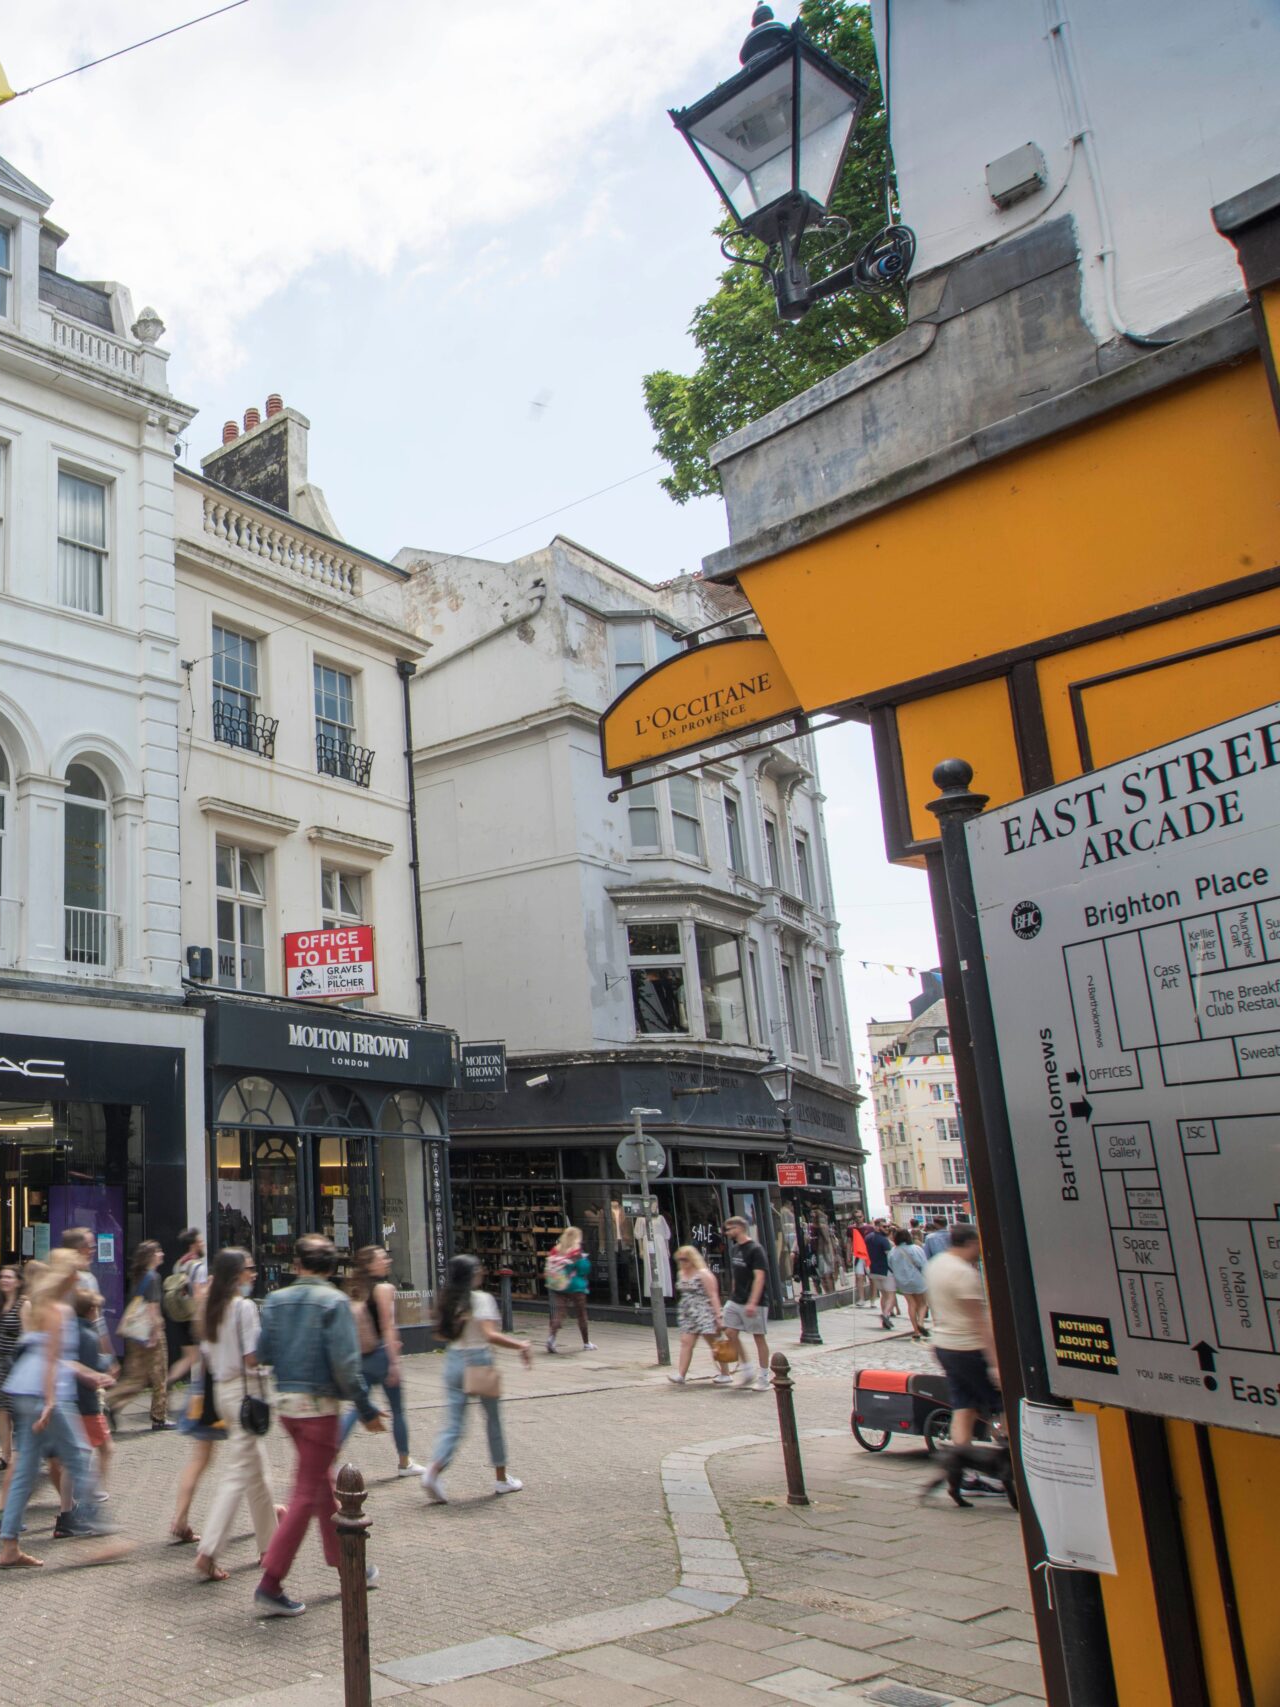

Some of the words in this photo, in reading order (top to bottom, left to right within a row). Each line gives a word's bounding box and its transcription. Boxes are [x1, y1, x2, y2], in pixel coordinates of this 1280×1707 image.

[635, 672, 772, 737] L'OCCITANE
[662, 730, 677, 741] EN
[681, 704, 747, 733] PROVENCE
[1000, 783, 1106, 857] EAST
[1079, 790, 1245, 870] ARCADE
[1084, 889, 1181, 928] Brighton
[1195, 867, 1269, 901] Place
[1014, 909, 1039, 930] BHC
[297, 931, 359, 949] OFFICE
[1188, 928, 1215, 942] Kellie
[294, 951, 320, 967] TO
[326, 947, 363, 964] LET
[327, 964, 363, 975] GRAVES
[1153, 963, 1181, 978] Cass
[327, 978, 364, 988] PILCHER
[1086, 975, 1094, 987] 2
[1160, 976, 1179, 990] Art
[1208, 988, 1235, 1003] The
[1087, 986, 1104, 1049] Bartholomews
[1205, 1001, 1234, 1018] Club
[288, 1023, 351, 1053] MOLTON
[353, 1032, 409, 1060] BROWN
[332, 1057, 370, 1068] LONDON
[465, 1054, 501, 1067] MOLTON
[465, 1066, 501, 1078] BROWN
[1088, 1065, 1132, 1081] OFFICES
[1040, 1027, 1080, 1202] Bartholomews
[1108, 1135, 1136, 1147] Cloud
[1108, 1147, 1141, 1159] Gallery
[691, 1223, 713, 1244] SALE
[1122, 1236, 1160, 1252] Space
[1134, 1251, 1154, 1265] NK
[1226, 1247, 1241, 1266] Jo
[422, 1289, 434, 1298] DAY
[1218, 1266, 1233, 1307] London
[1231, 1271, 1252, 1329] Malone
[1058, 1320, 1105, 1334] NOTHING
[1059, 1335, 1092, 1348] ABOUT
[1094, 1339, 1110, 1350] US
[1055, 1349, 1101, 1363] WITHOUT
[1103, 1355, 1119, 1366] US
[1135, 1368, 1154, 1379] YOU
[1158, 1372, 1176, 1383] ARE
[1178, 1375, 1202, 1387] HERE
